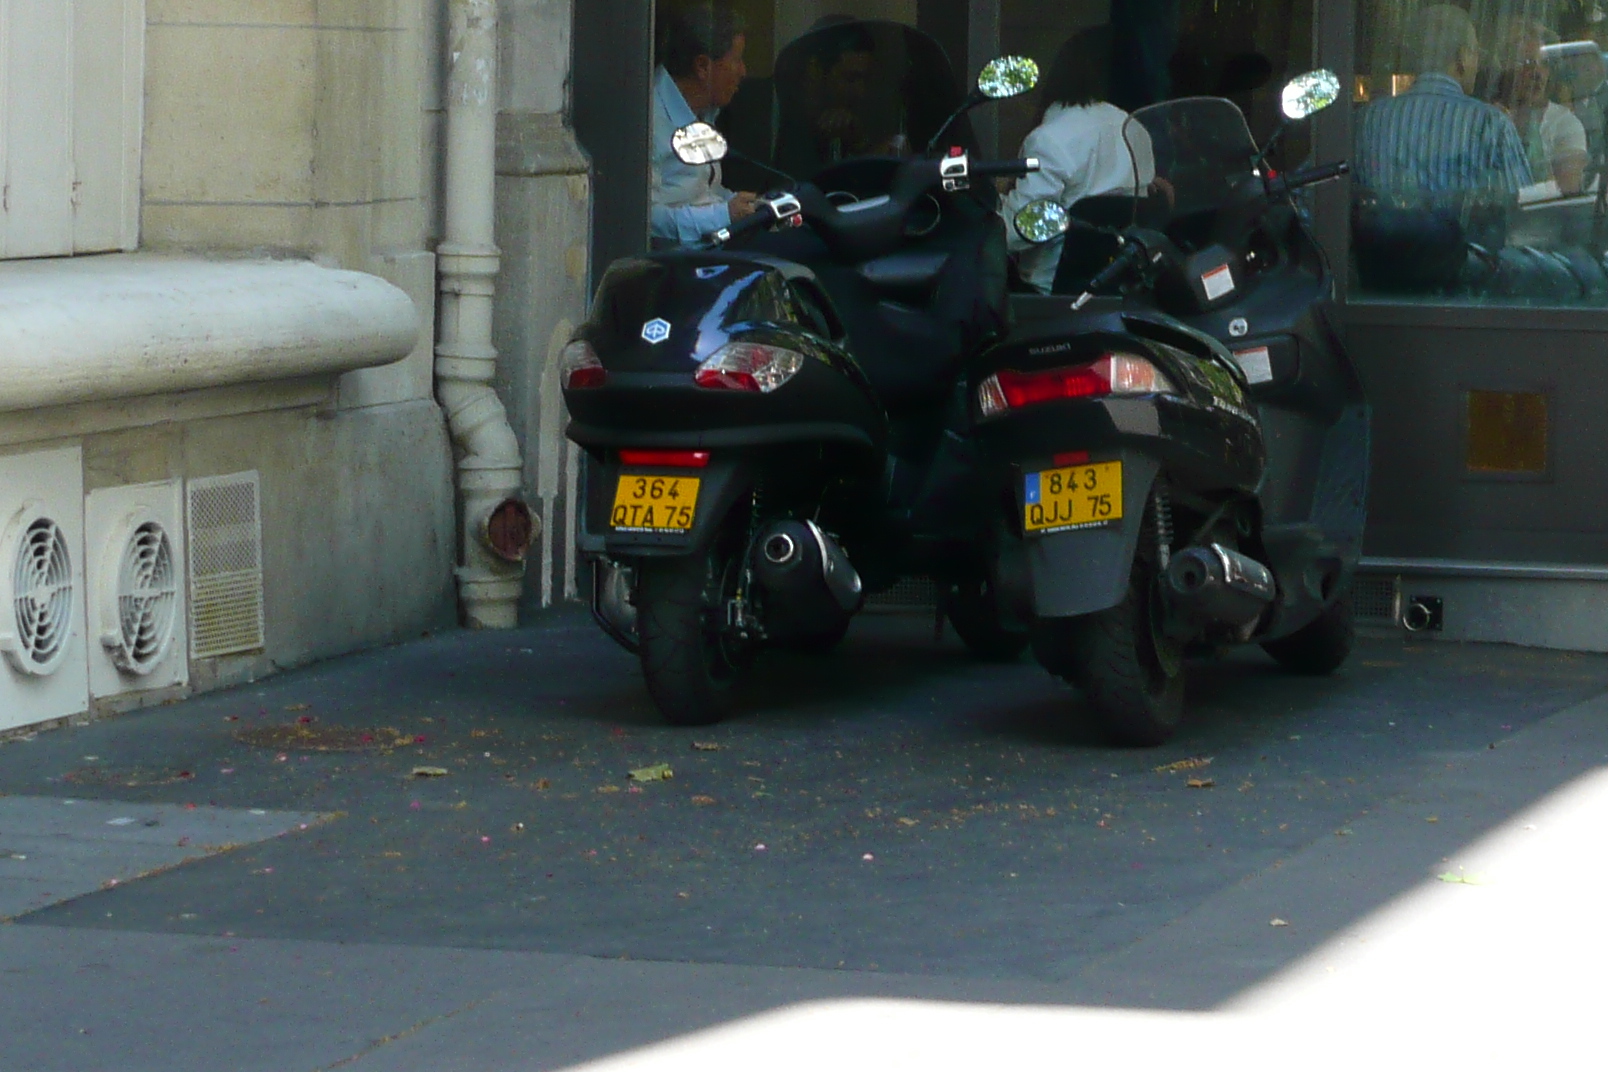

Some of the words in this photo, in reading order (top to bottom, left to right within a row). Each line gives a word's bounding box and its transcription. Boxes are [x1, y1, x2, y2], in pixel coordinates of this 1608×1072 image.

[632, 478, 680, 500] 364
[1050, 469, 1098, 495] 843
[612, 505, 655, 526] QTA
[664, 505, 692, 527] 75
[1030, 499, 1073, 526] QJJ
[1087, 494, 1112, 518] 75
